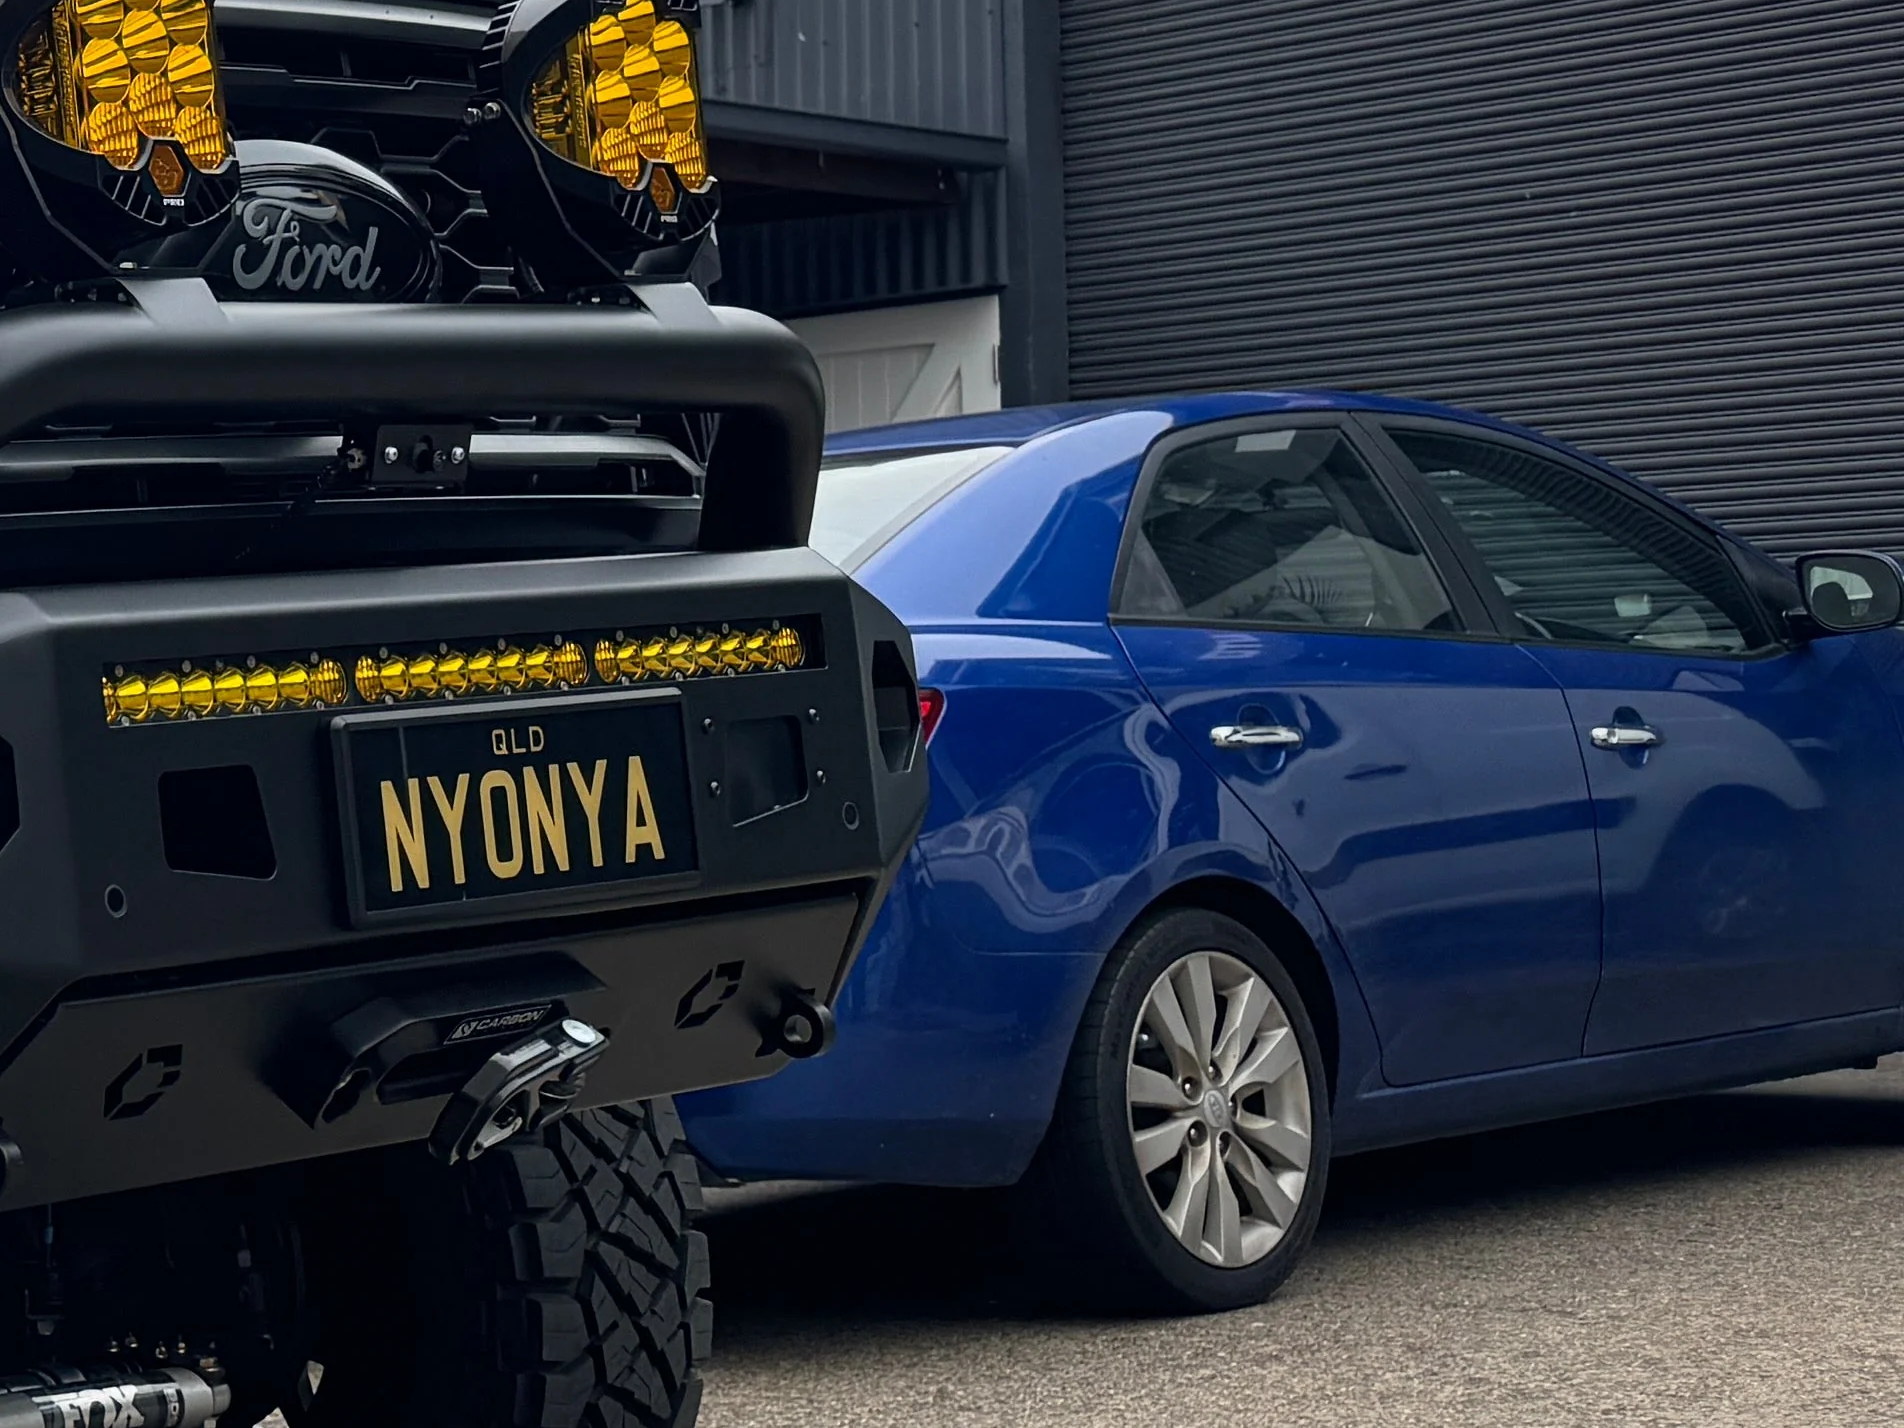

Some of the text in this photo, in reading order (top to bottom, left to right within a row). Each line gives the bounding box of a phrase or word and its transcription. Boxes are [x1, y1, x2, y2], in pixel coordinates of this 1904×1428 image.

[233, 198, 381, 291] Ford
[491, 724, 545, 756] QLD
[380, 755, 666, 893] NYONYA
[477, 1009, 544, 1031] CARBON
